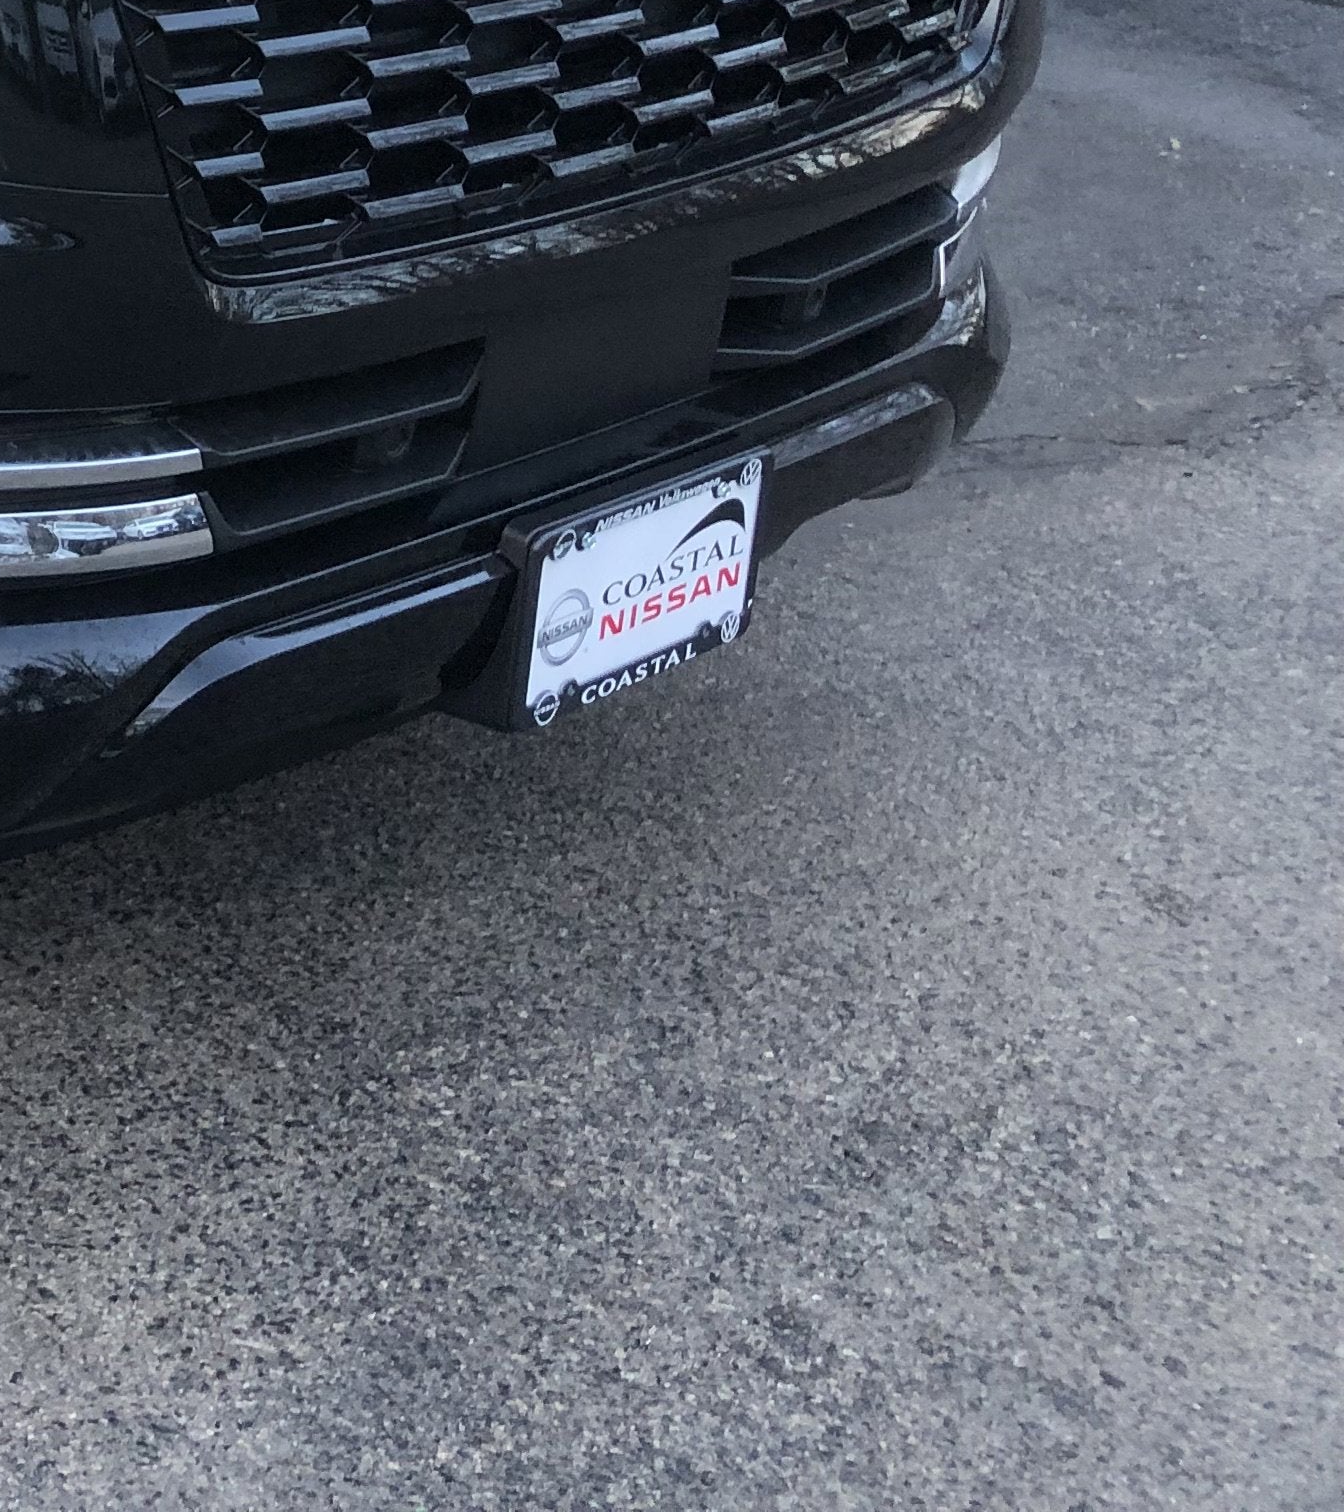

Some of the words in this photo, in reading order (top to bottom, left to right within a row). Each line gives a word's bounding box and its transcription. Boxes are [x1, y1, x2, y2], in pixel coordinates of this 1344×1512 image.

[594, 499, 656, 533] NISSAN
[598, 562, 741, 641] NISSAN
[602, 535, 744, 606] COASTAL
[541, 614, 590, 642] NISSAN
[581, 642, 697, 705] COASTAL
